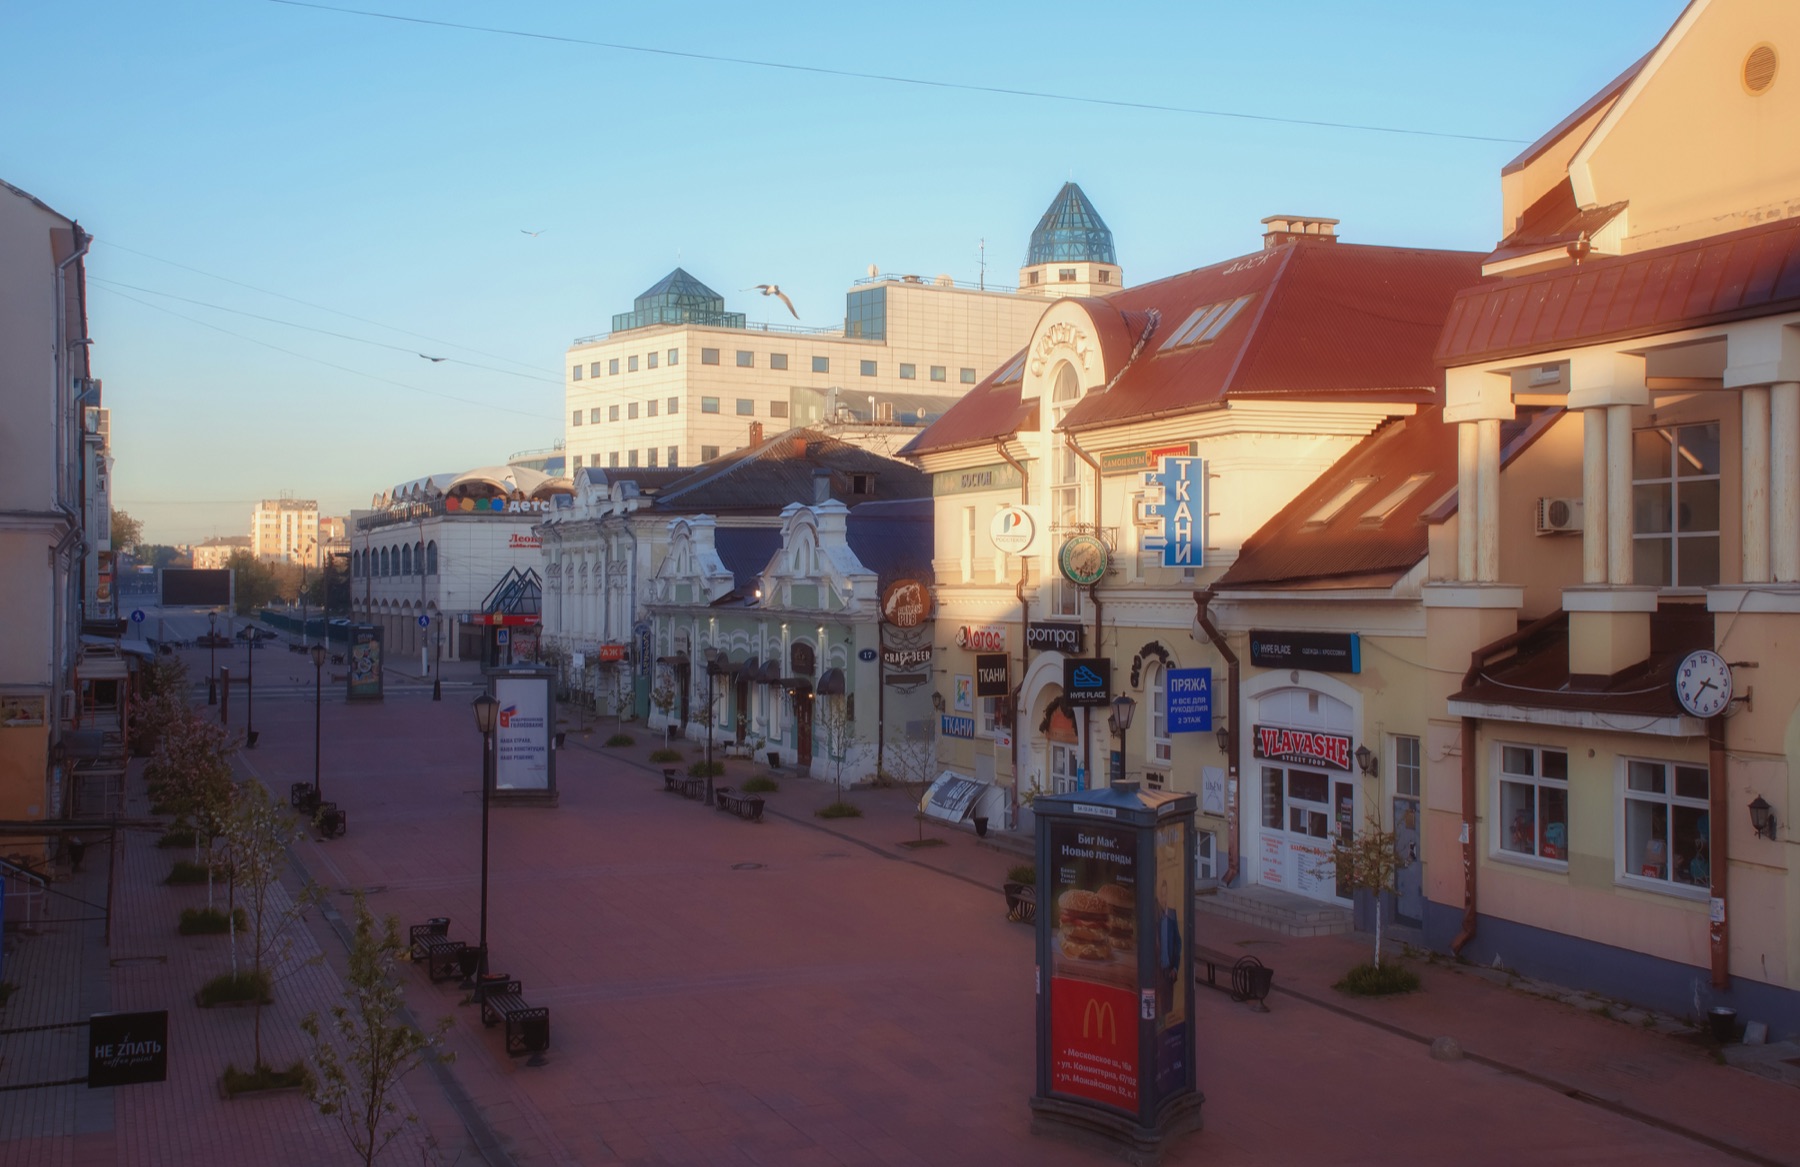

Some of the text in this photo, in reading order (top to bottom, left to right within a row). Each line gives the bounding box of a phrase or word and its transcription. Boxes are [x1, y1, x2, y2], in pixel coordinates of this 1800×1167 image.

[1103, 454, 1145, 468] САМОЦВЕТЫ
[961, 471, 992, 488] БОСТОН
[1150, 473, 1157, 482] 2
[1150, 504, 1157, 514] 8
[1174, 460, 1192, 564] ТКАНИ
[898, 613, 917, 626] PUB
[1027, 627, 1076, 648] pompa
[1260, 644, 1274, 654] HYPE
[912, 650, 931, 661] BEER
[1700, 656, 1707, 664] 12
[1691, 660, 1696, 668] 11
[1712, 659, 1715, 667] 1
[979, 668, 1006, 683] ТКАНИ
[1684, 669, 1691, 677] 10
[1719, 667, 1724, 675] 2
[1171, 678, 1207, 692] ПРЯЖА
[1681, 681, 1686, 689] 9
[1723, 679, 1727, 687] 3
[1087, 691, 1106, 699] PLACE
[1685, 693, 1690, 701] 8
[1720, 691, 1725, 699] 4
[1703, 704, 1708, 712] 6
[1183, 716, 1201, 724] ЭТАЖ
[944, 717, 973, 737] ТКАНИ
[1260, 727, 1349, 770] VLAVASHE
[1282, 754, 1326, 766] STREET FOOD
[1078, 833, 1095, 845] Биг
[1062, 845, 1132, 865] Новые легенды
[95, 1044, 113, 1058] НЕ
[1068, 1048, 1111, 1065] Московское
[1062, 1061, 1072, 1069] ул.
[1061, 1073, 1071, 1081] ул.
